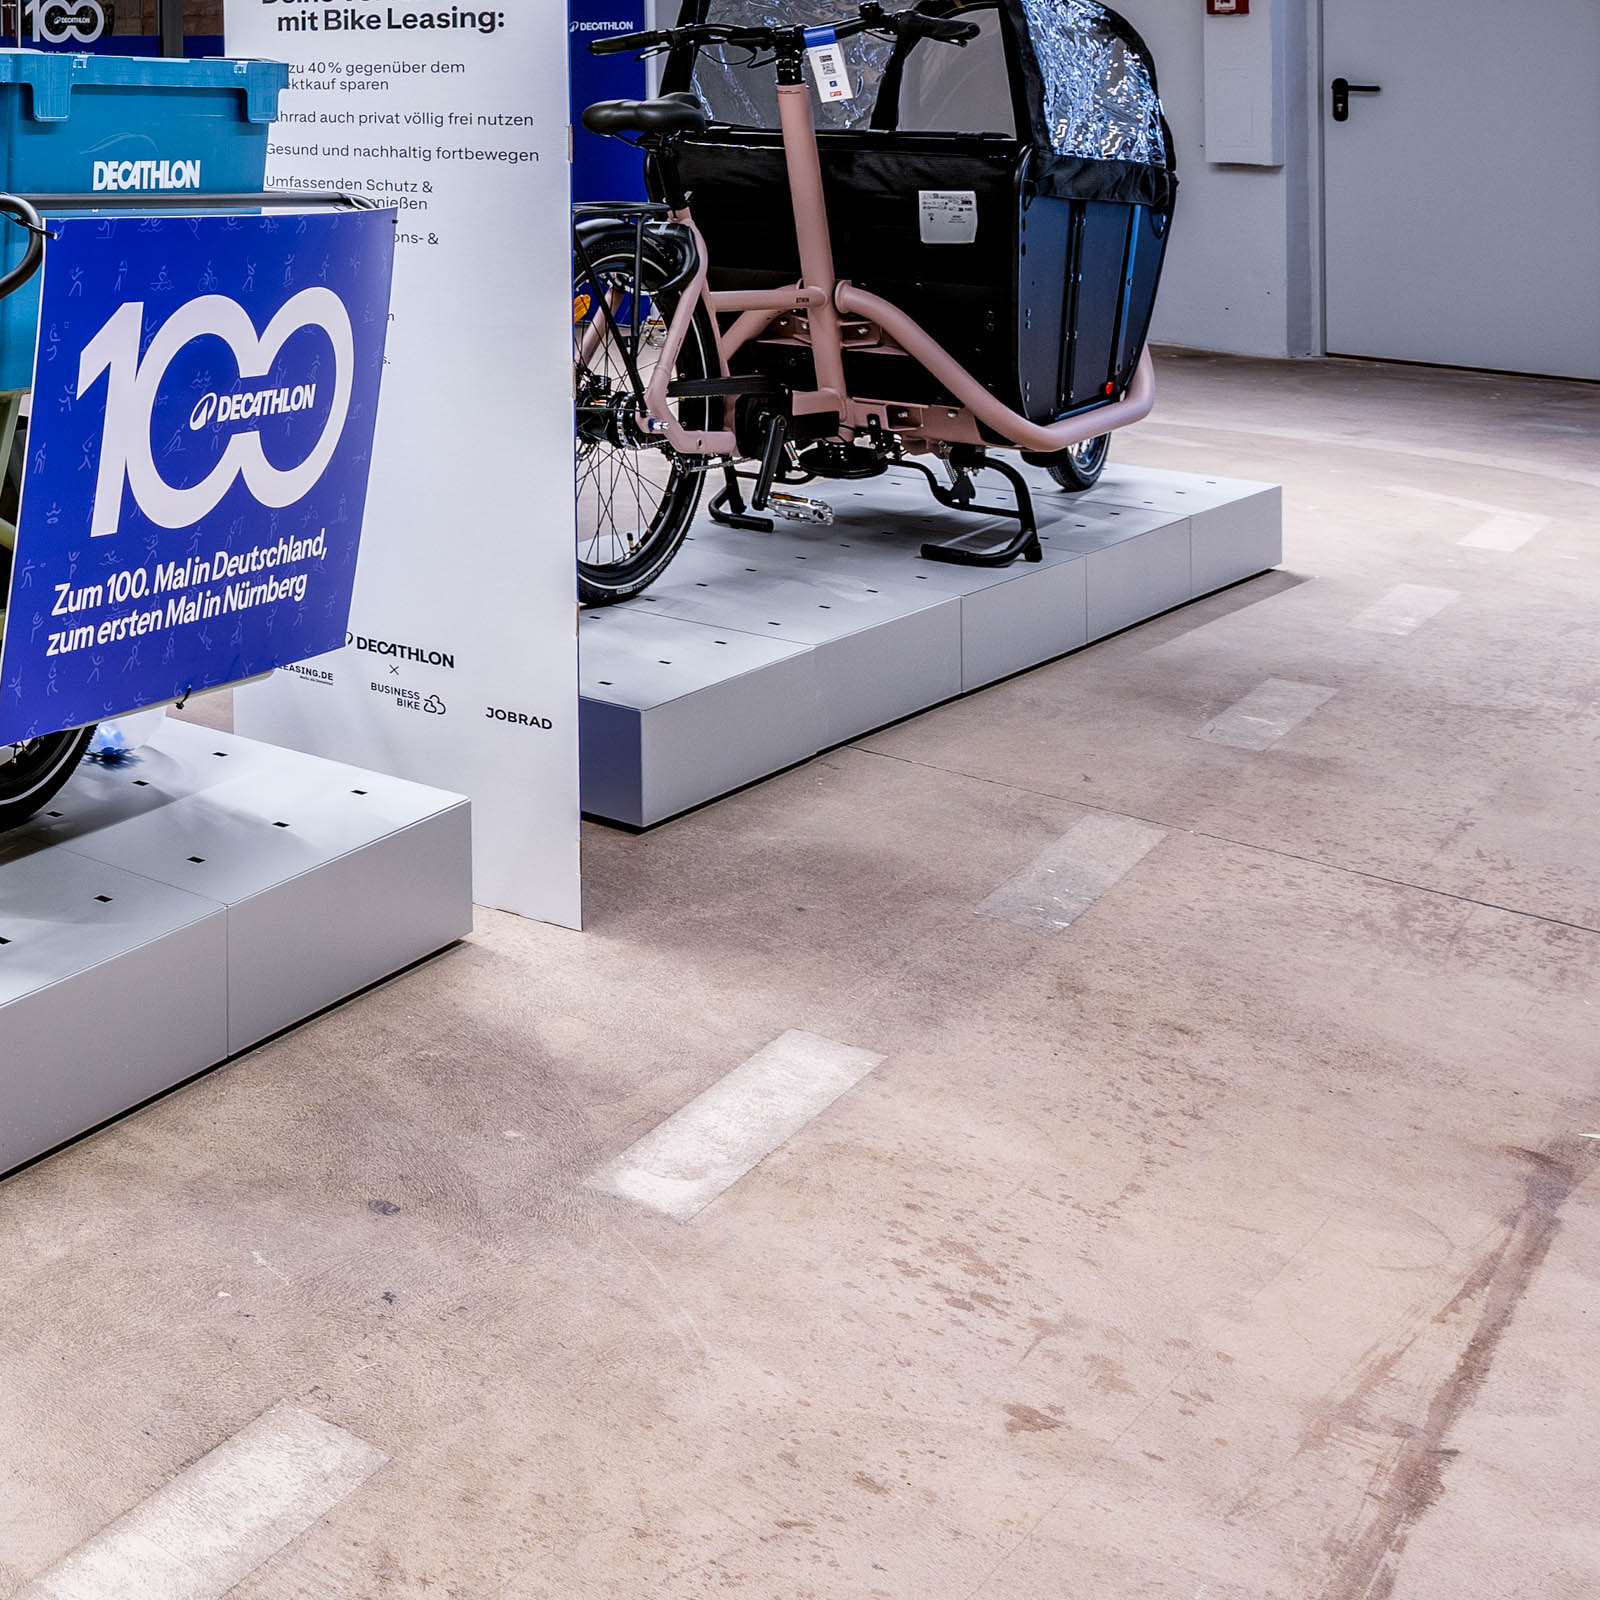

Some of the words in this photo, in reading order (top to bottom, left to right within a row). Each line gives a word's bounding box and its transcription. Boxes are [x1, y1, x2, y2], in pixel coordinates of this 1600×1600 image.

[277, 8, 319, 32] mit
[323, 8, 382, 31] Bike
[386, 5, 505, 34] Leasing:
[579, 20, 634, 32] DECATHLON
[288, 63, 305, 74] zu
[345, 61, 427, 77] gegenüber
[430, 61, 466, 73] dem
[340, 80, 389, 93] sparen
[320, 111, 355, 123] auch
[358, 112, 400, 127] privat
[404, 111, 444, 128] völlig
[448, 112, 473, 126] frei
[477, 113, 534, 127] nutzen
[266, 143, 318, 156] Gesund
[322, 144, 350, 157] und
[353, 144, 432, 162] nachhaltig
[435, 146, 540, 167] fortbewegen
[93, 159, 201, 191] DECATHLON
[265, 175, 363, 191] Umfassenden
[366, 178, 418, 193] Schutz
[421, 180, 434, 193] &
[428, 233, 439, 245] &
[76, 286, 355, 538] 100
[217, 383, 316, 423] DECATHLON
[51, 583, 104, 617] Zum
[106, 570, 150, 604] 100.
[153, 558, 191, 595] Mal
[191, 554, 210, 585] in
[211, 527, 328, 581] Deutschland,
[45, 624, 97, 657] zum
[97, 609, 163, 647] ersten
[164, 595, 203, 632] Mal
[203, 591, 221, 620] in
[223, 570, 308, 614] Nürnberg
[356, 636, 455, 669] DECATHLON
[279, 664, 334, 681] EASING.DE
[370, 682, 420, 700] BUSINESS
[396, 697, 421, 711] BIKE
[485, 707, 553, 730] JOBRAD
